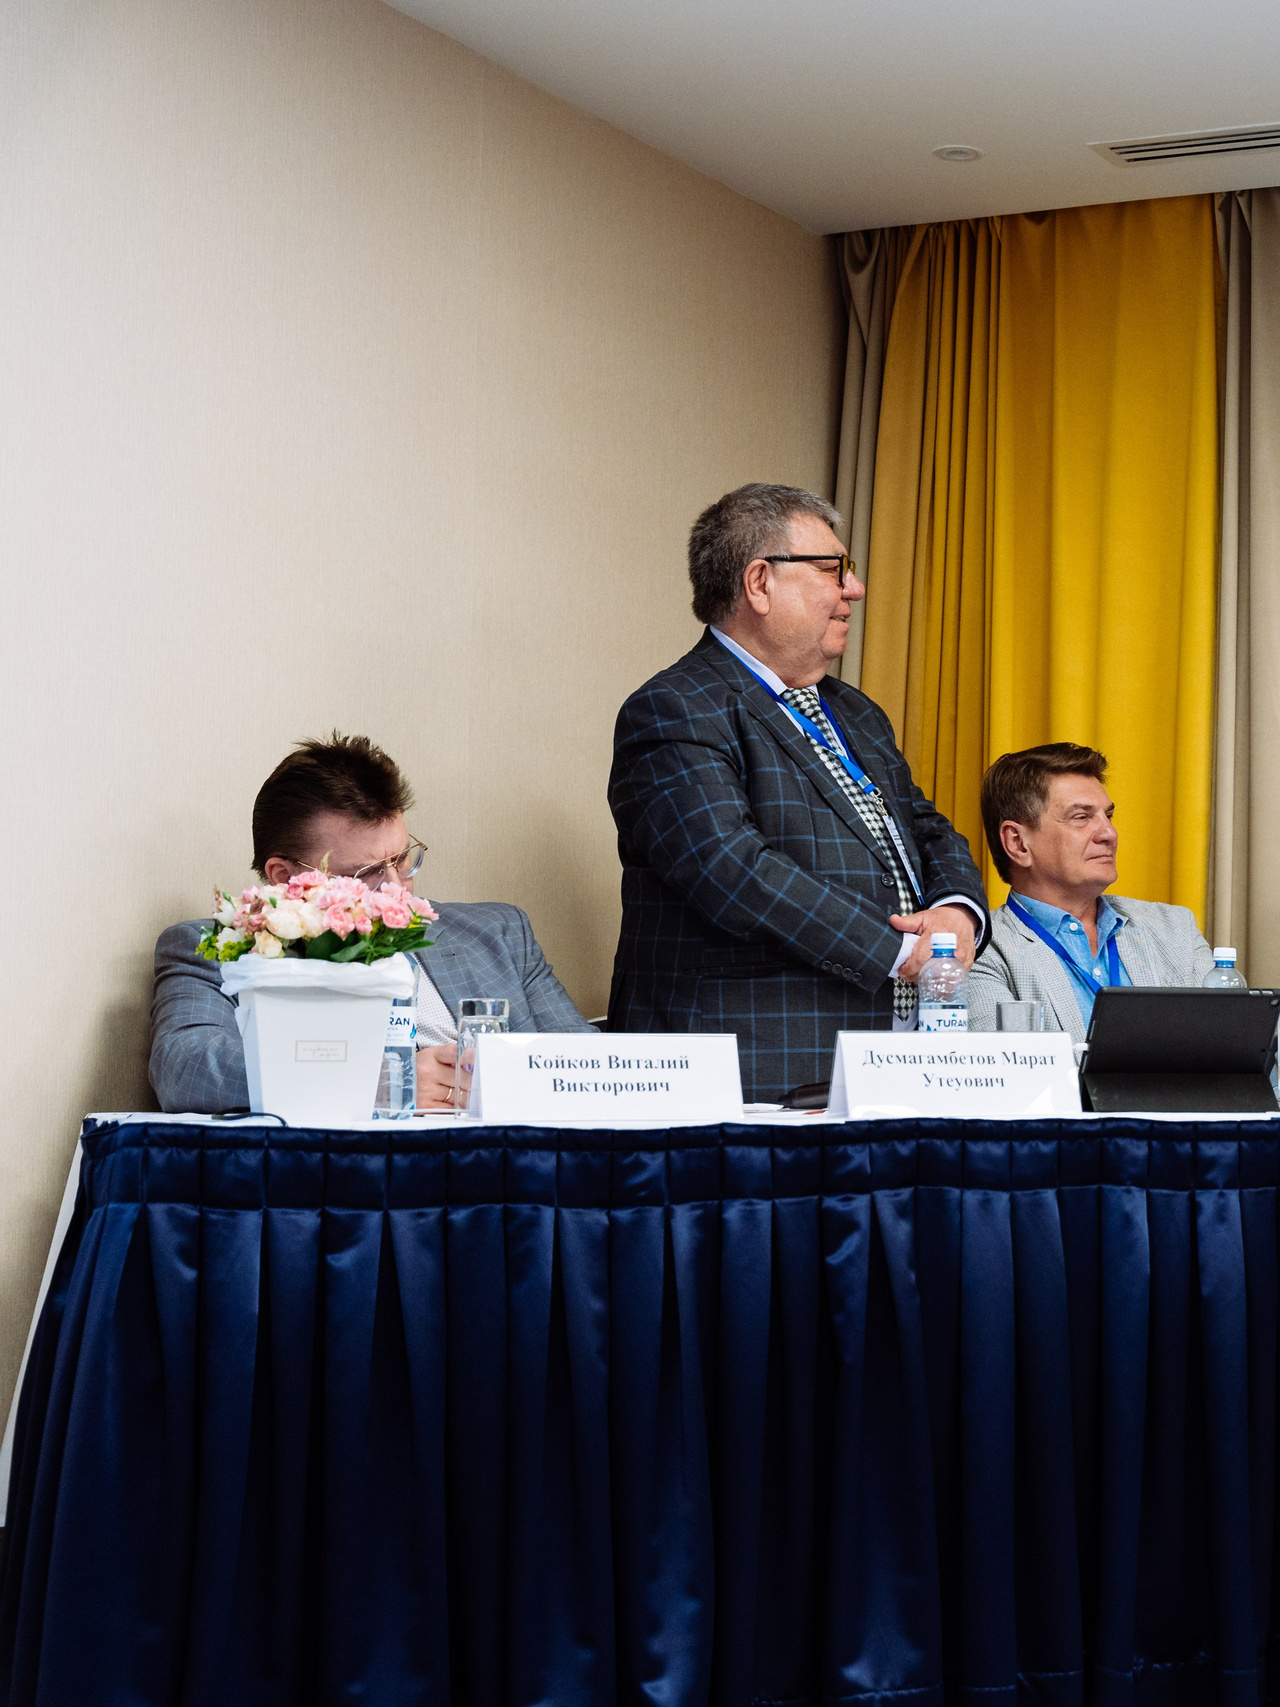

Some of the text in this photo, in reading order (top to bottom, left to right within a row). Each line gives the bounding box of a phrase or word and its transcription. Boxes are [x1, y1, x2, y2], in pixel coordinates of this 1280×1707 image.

[389, 1016, 410, 1026] RAN
[527, 1054, 690, 1069] Койков Виталий
[862, 1050, 1057, 1069] Дусмагамбетов Марат
[552, 1077, 670, 1096] Викторович
[922, 1073, 1005, 1091] Утеуович
